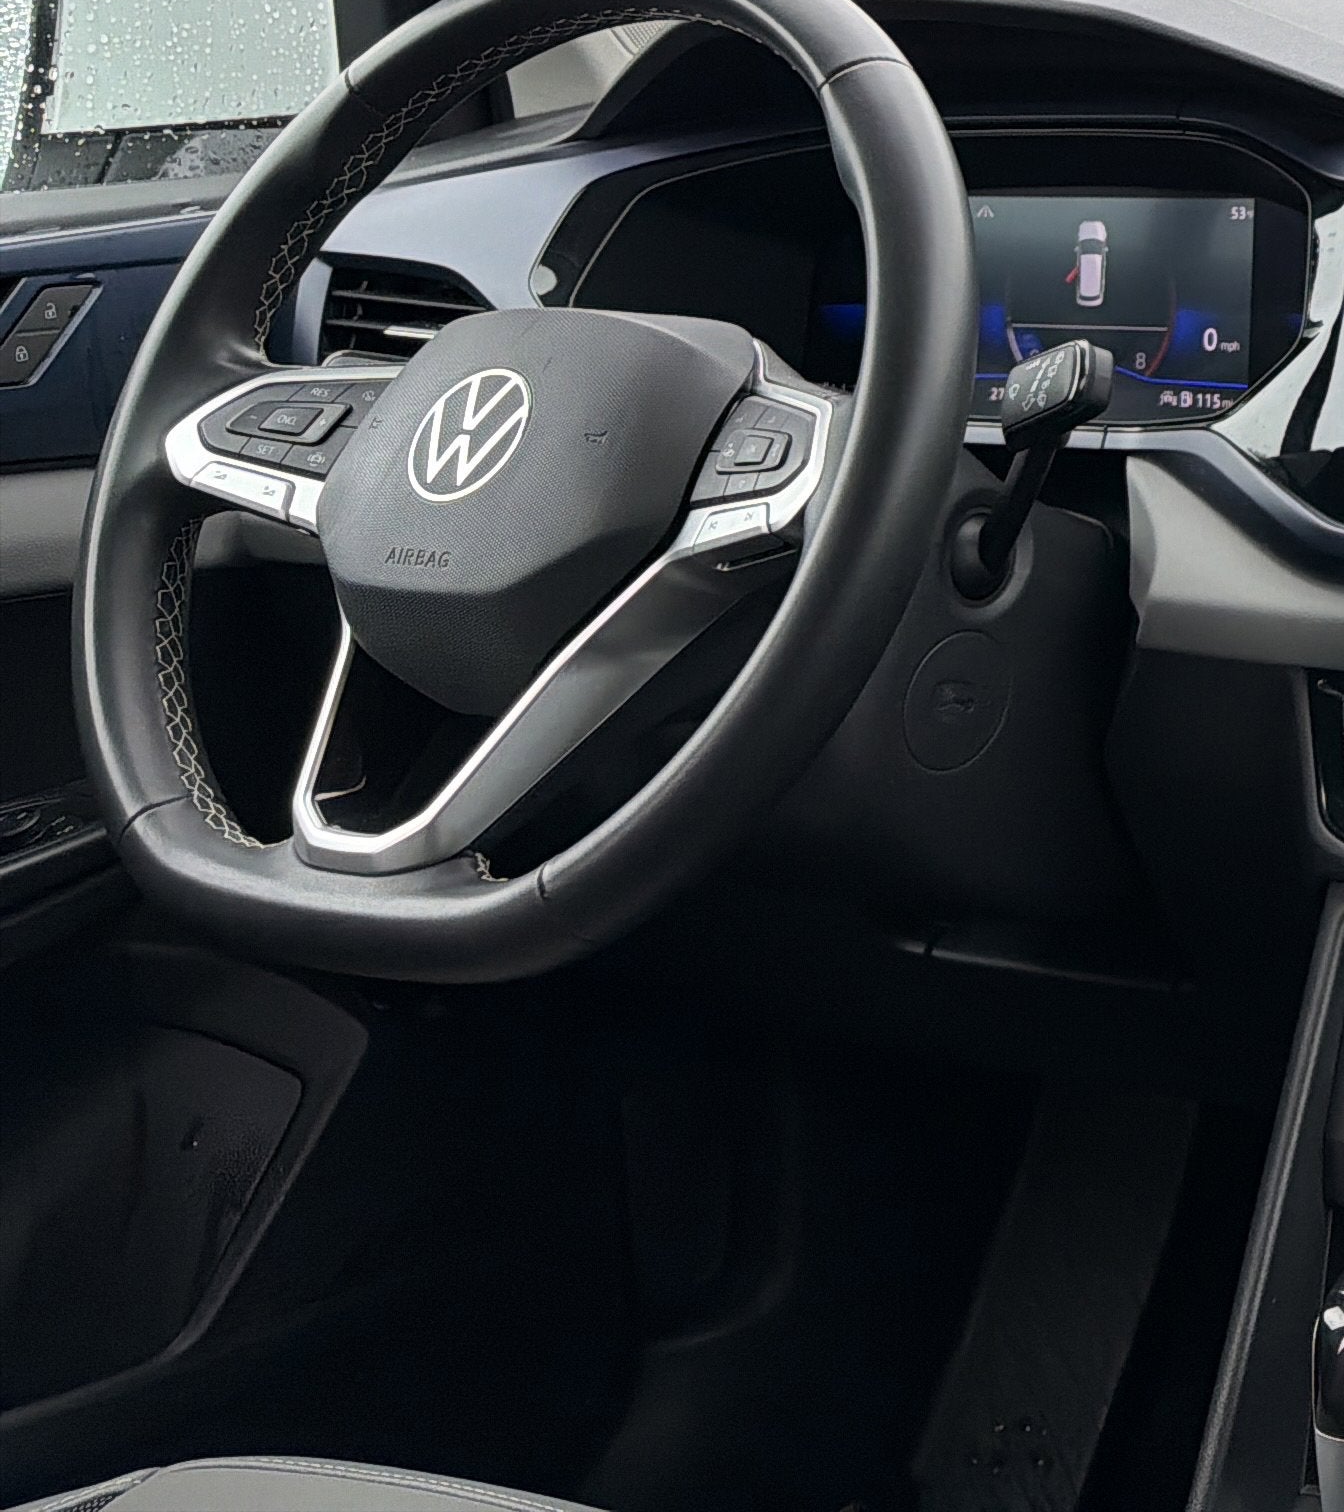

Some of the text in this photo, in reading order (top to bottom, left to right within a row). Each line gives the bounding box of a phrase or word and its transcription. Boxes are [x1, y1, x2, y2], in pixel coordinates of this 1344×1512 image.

[1203, 327, 1240, 352] 0 mph
[1136, 352, 1147, 370] 8
[309, 387, 329, 398] RES
[1196, 393, 1221, 408] 115
[256, 444, 274, 455] SET
[384, 546, 451, 568] AIRBAG
